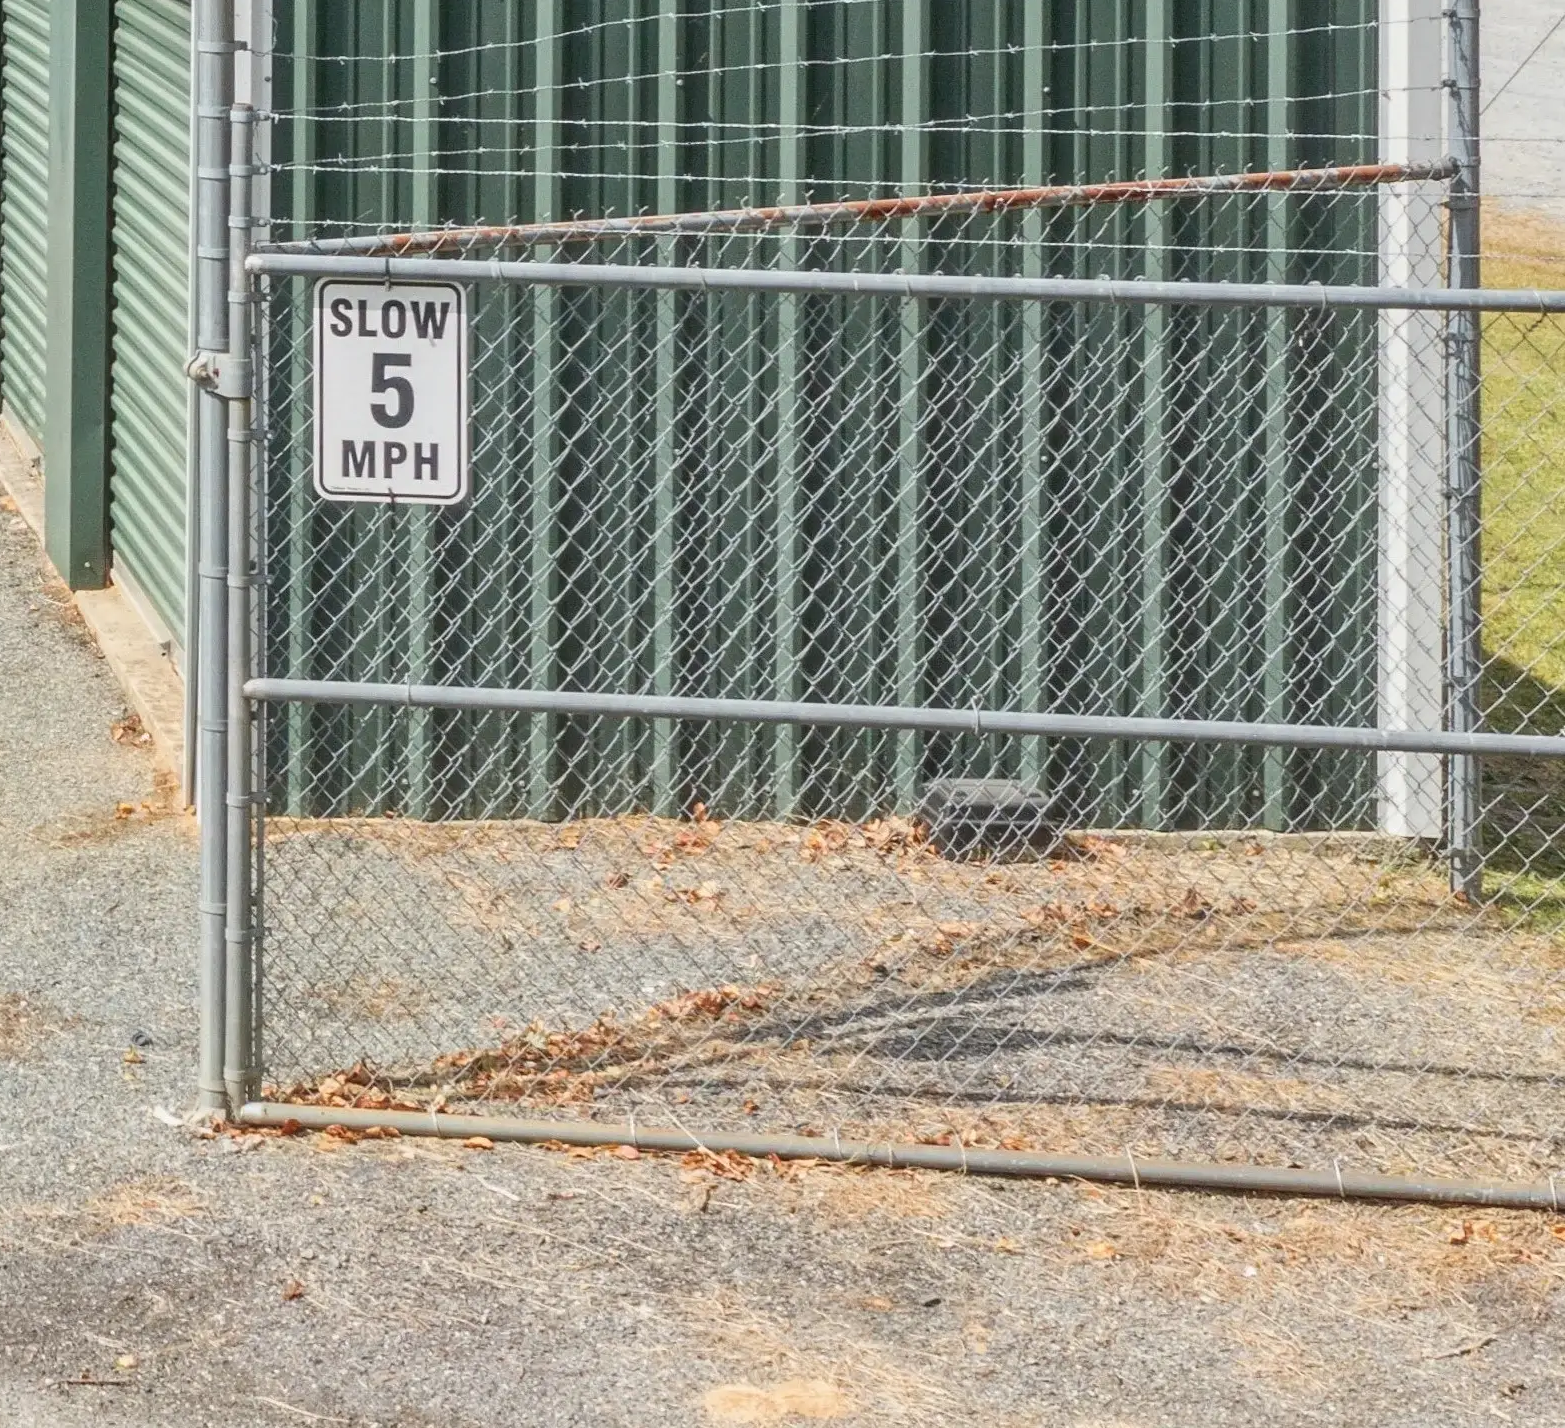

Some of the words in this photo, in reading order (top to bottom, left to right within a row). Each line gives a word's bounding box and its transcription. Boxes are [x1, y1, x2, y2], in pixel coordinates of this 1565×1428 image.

[330, 298, 450, 339] SLOW
[370, 352, 415, 429] 5
[342, 439, 439, 481] MPH
